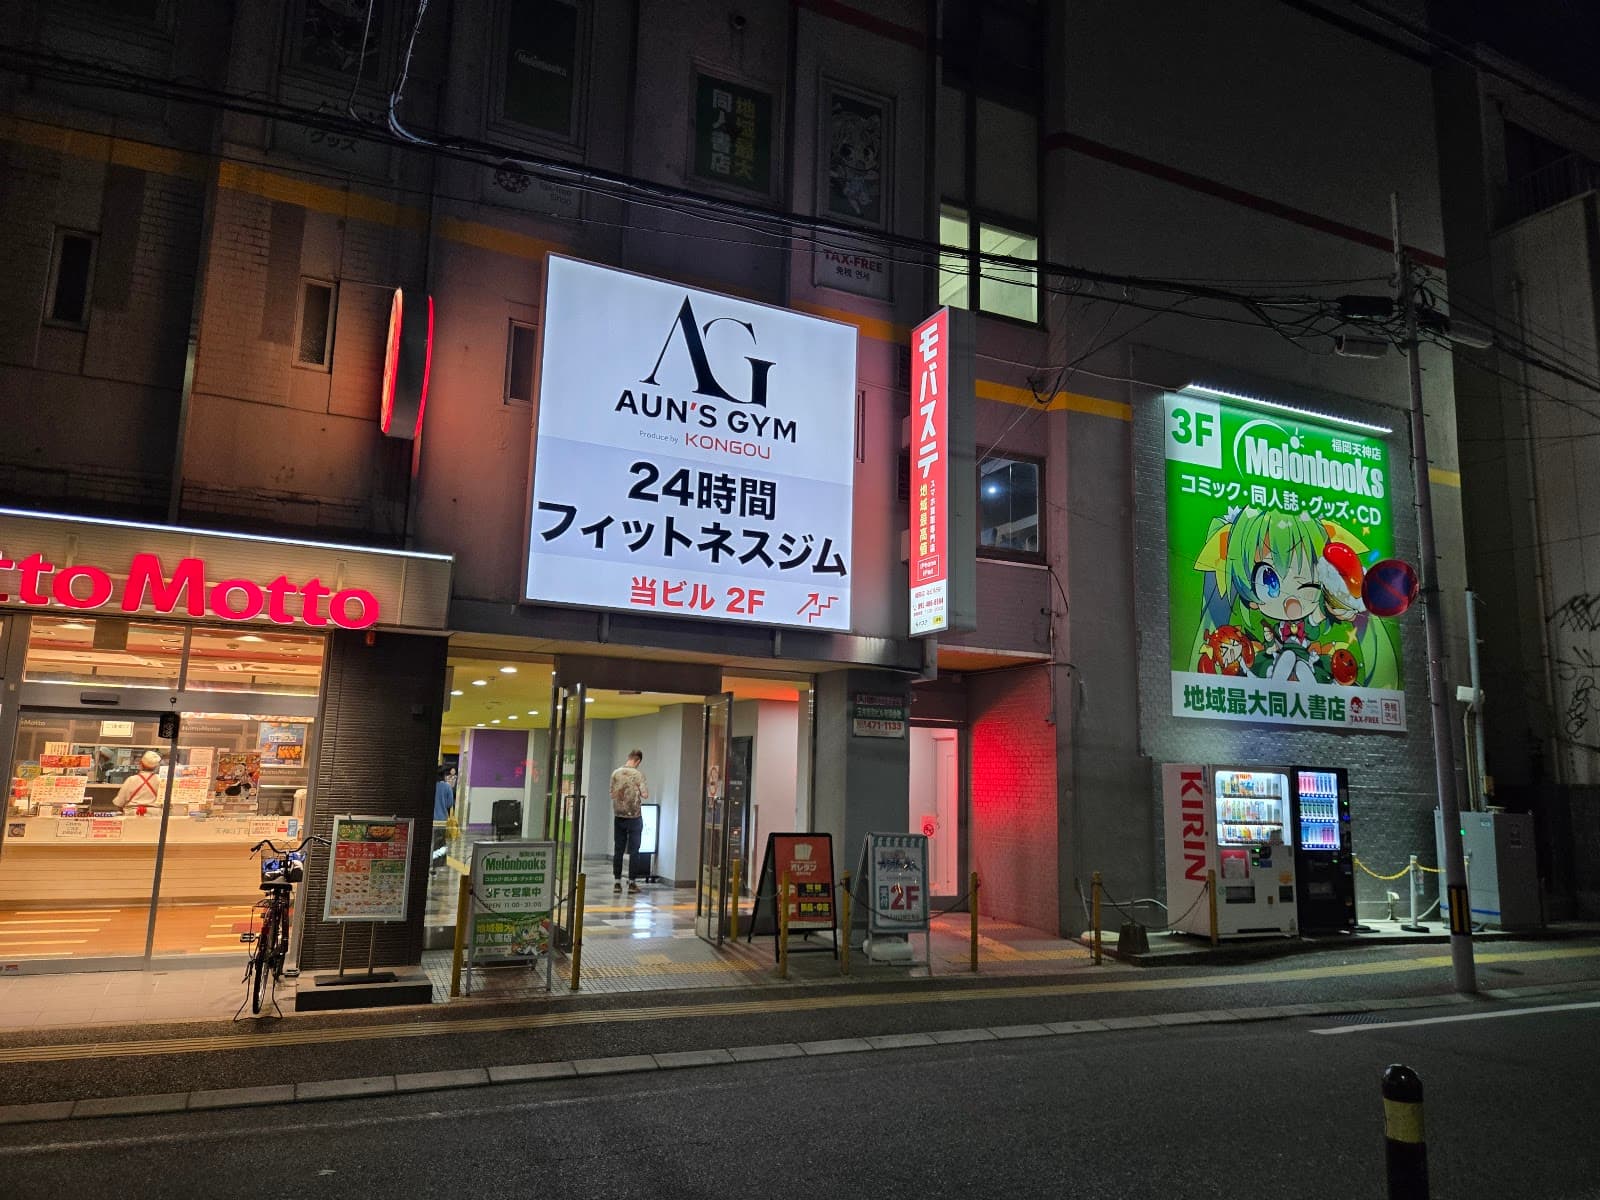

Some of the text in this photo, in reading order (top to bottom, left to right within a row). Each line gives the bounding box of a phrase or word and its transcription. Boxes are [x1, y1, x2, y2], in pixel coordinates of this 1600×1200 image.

[823, 249, 883, 273] TAX-FREE
[614, 389, 797, 443] AUN'S GYM
[918, 322, 939, 479] モバステ
[639, 430, 771, 460] Produce by KONGOU
[1171, 408, 1214, 447] 3F
[1245, 435, 1385, 499] Melonbooks
[1331, 438, 1383, 461] 福岡天神店
[627, 461, 777, 521] 24時間
[537, 501, 848, 577] フィットネスジム
[121, 552, 381, 630] Motto
[630, 575, 765, 614] 当ビル 2F
[1183, 684, 1346, 722] 地域最大同人書店
[1180, 770, 1208, 882] KIRIN
[485, 856, 547, 872] Melonbooks
[890, 884, 920, 911] 2F
